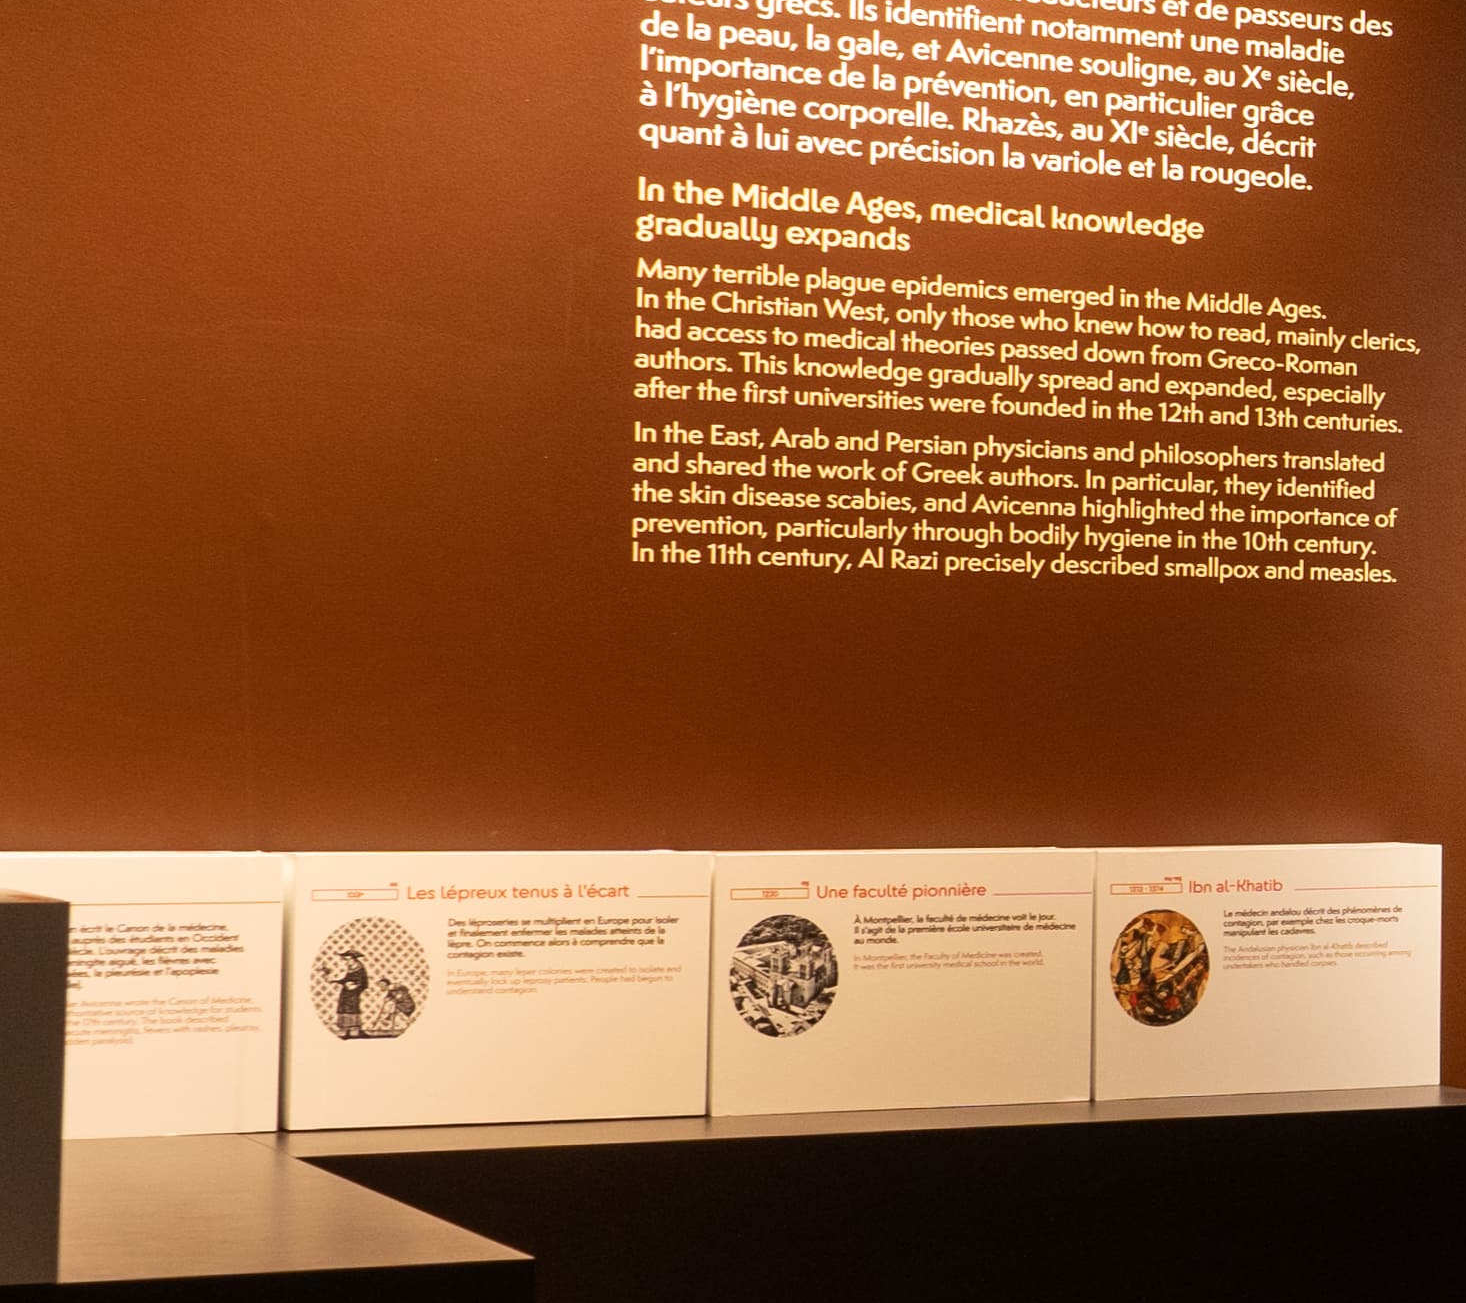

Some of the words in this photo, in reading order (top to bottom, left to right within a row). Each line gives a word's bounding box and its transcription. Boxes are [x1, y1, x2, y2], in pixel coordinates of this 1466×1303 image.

[638, 123, 725, 150] quant
[730, 121, 748, 149] à
[755, 122, 789, 151] lui
[795, 134, 863, 157] avec
[869, 135, 995, 167] précision
[1002, 141, 1025, 170] la
[1030, 148, 1122, 177] variole
[1127, 156, 1156, 179] et
[1161, 153, 1184, 181] la
[1190, 163, 1313, 193] rougeole.
[638, 175, 665, 202] In
[672, 178, 724, 206] the
[732, 182, 840, 214] Middle
[845, 190, 922, 224] Ages,
[930, 200, 1046, 229] medical
[1051, 205, 1205, 245] knowledge
[635, 212, 778, 250] gradually
[785, 225, 911, 253] expands
[632, 540, 654, 563] In
[660, 540, 701, 564] the
[707, 542, 751, 565] 11th
[757, 548, 852, 574] century,
[857, 546, 884, 568] Al
[891, 548, 938, 570] Razi
[945, 550, 1046, 579] precisely
[1050, 551, 1159, 576] described
[1164, 556, 1260, 584] smallpox
[1264, 558, 1304, 580] and
[1310, 560, 1397, 583] measles.
[407, 886, 435, 900] Les
[441, 885, 506, 902] lépreux
[512, 887, 558, 899] tenus
[563, 884, 573, 898] à
[578, 884, 629, 898] l'écart
[817, 885, 848, 899] Une
[853, 884, 908, 898] faculté
[913, 883, 987, 900] pionnière
[1189, 881, 1212, 893] Ibn
[1216, 879, 1283, 893] al-Khatib
